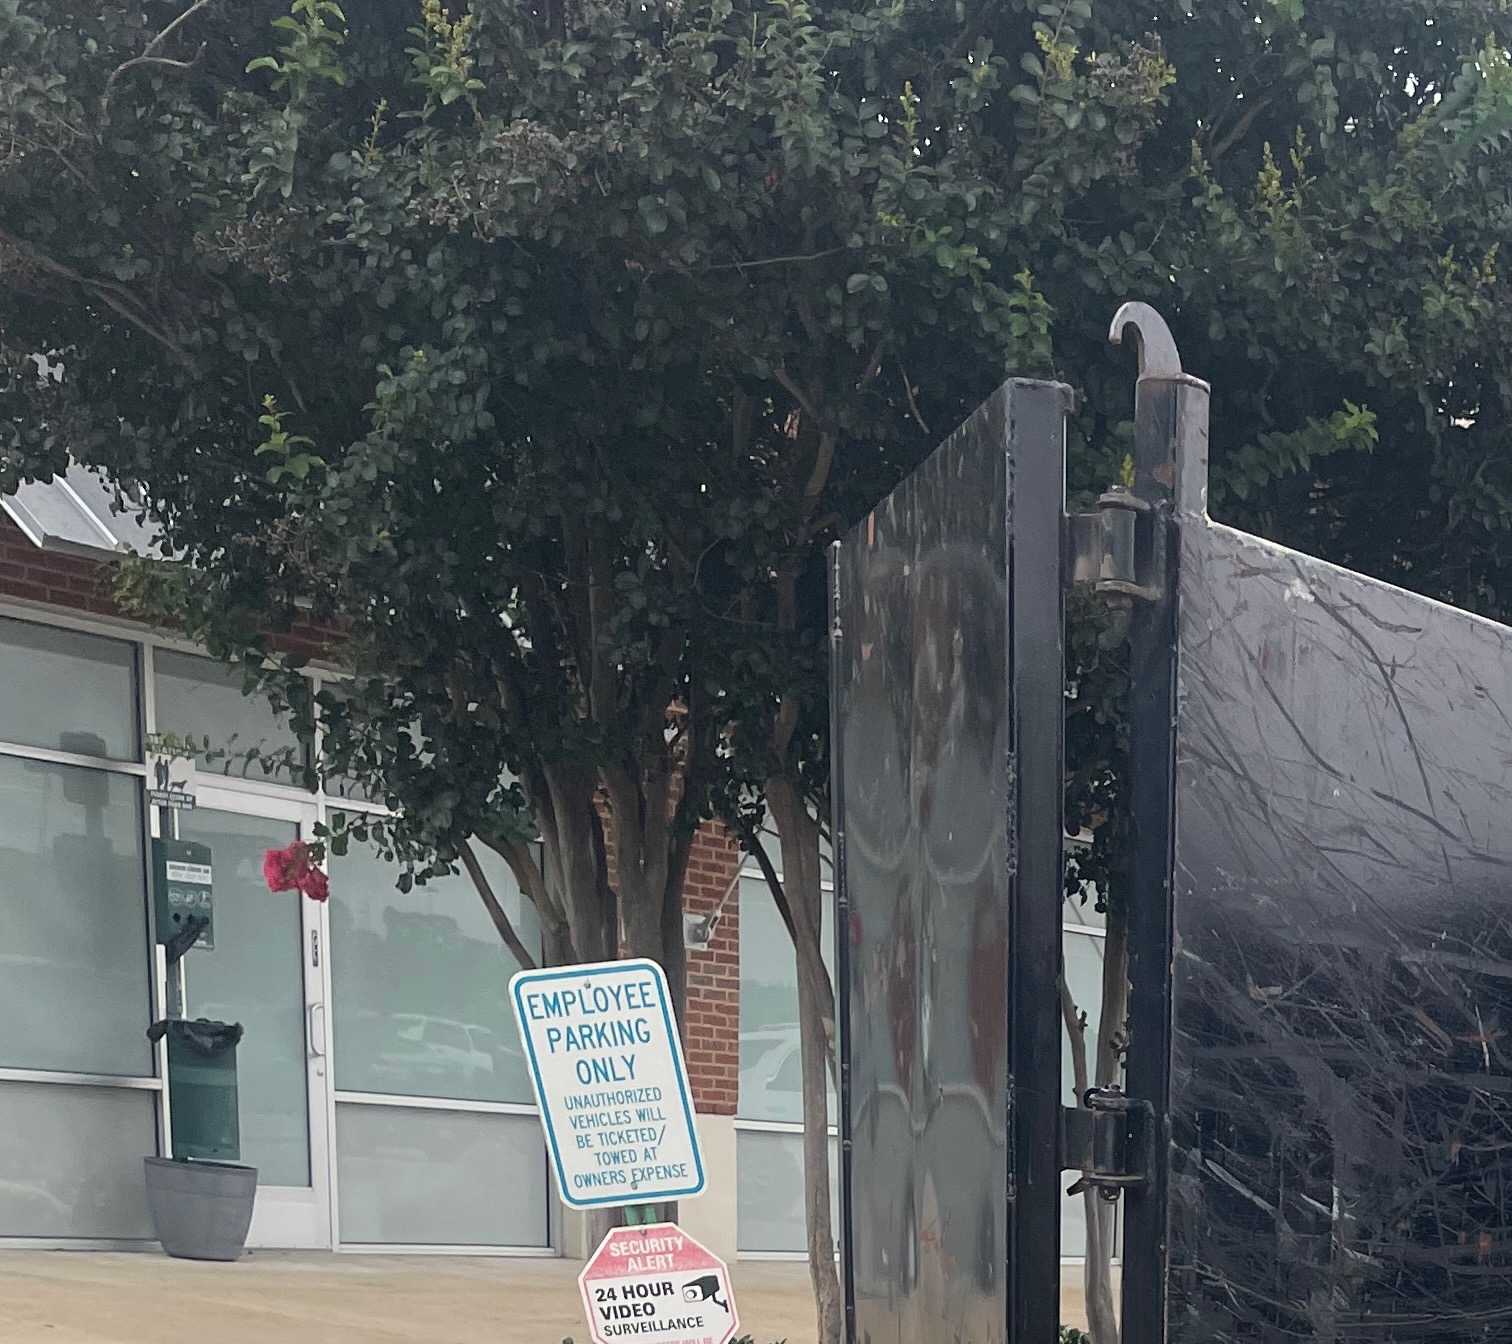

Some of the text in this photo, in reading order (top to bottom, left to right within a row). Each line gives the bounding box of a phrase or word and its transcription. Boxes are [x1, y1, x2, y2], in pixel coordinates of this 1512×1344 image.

[526, 982, 656, 1020] EMPLOYEE
[546, 1018, 651, 1053] PARKING
[576, 1054, 636, 1085] ONLY
[564, 1087, 662, 1111] UNAUTHORIZED
[569, 1107, 667, 1130] VEHICLES WILL
[576, 1124, 666, 1149] BE TICKETED/
[594, 1146, 658, 1167] TOWED AT
[574, 1163, 688, 1188] OWNERS EXPENSE
[609, 1236, 684, 1257] SECURITY
[627, 1253, 675, 1273] ALERT
[595, 1281, 675, 1302] 24 HOUR
[599, 1302, 656, 1321] VIDEO
[604, 1316, 705, 1337] SURVEILLANCE
